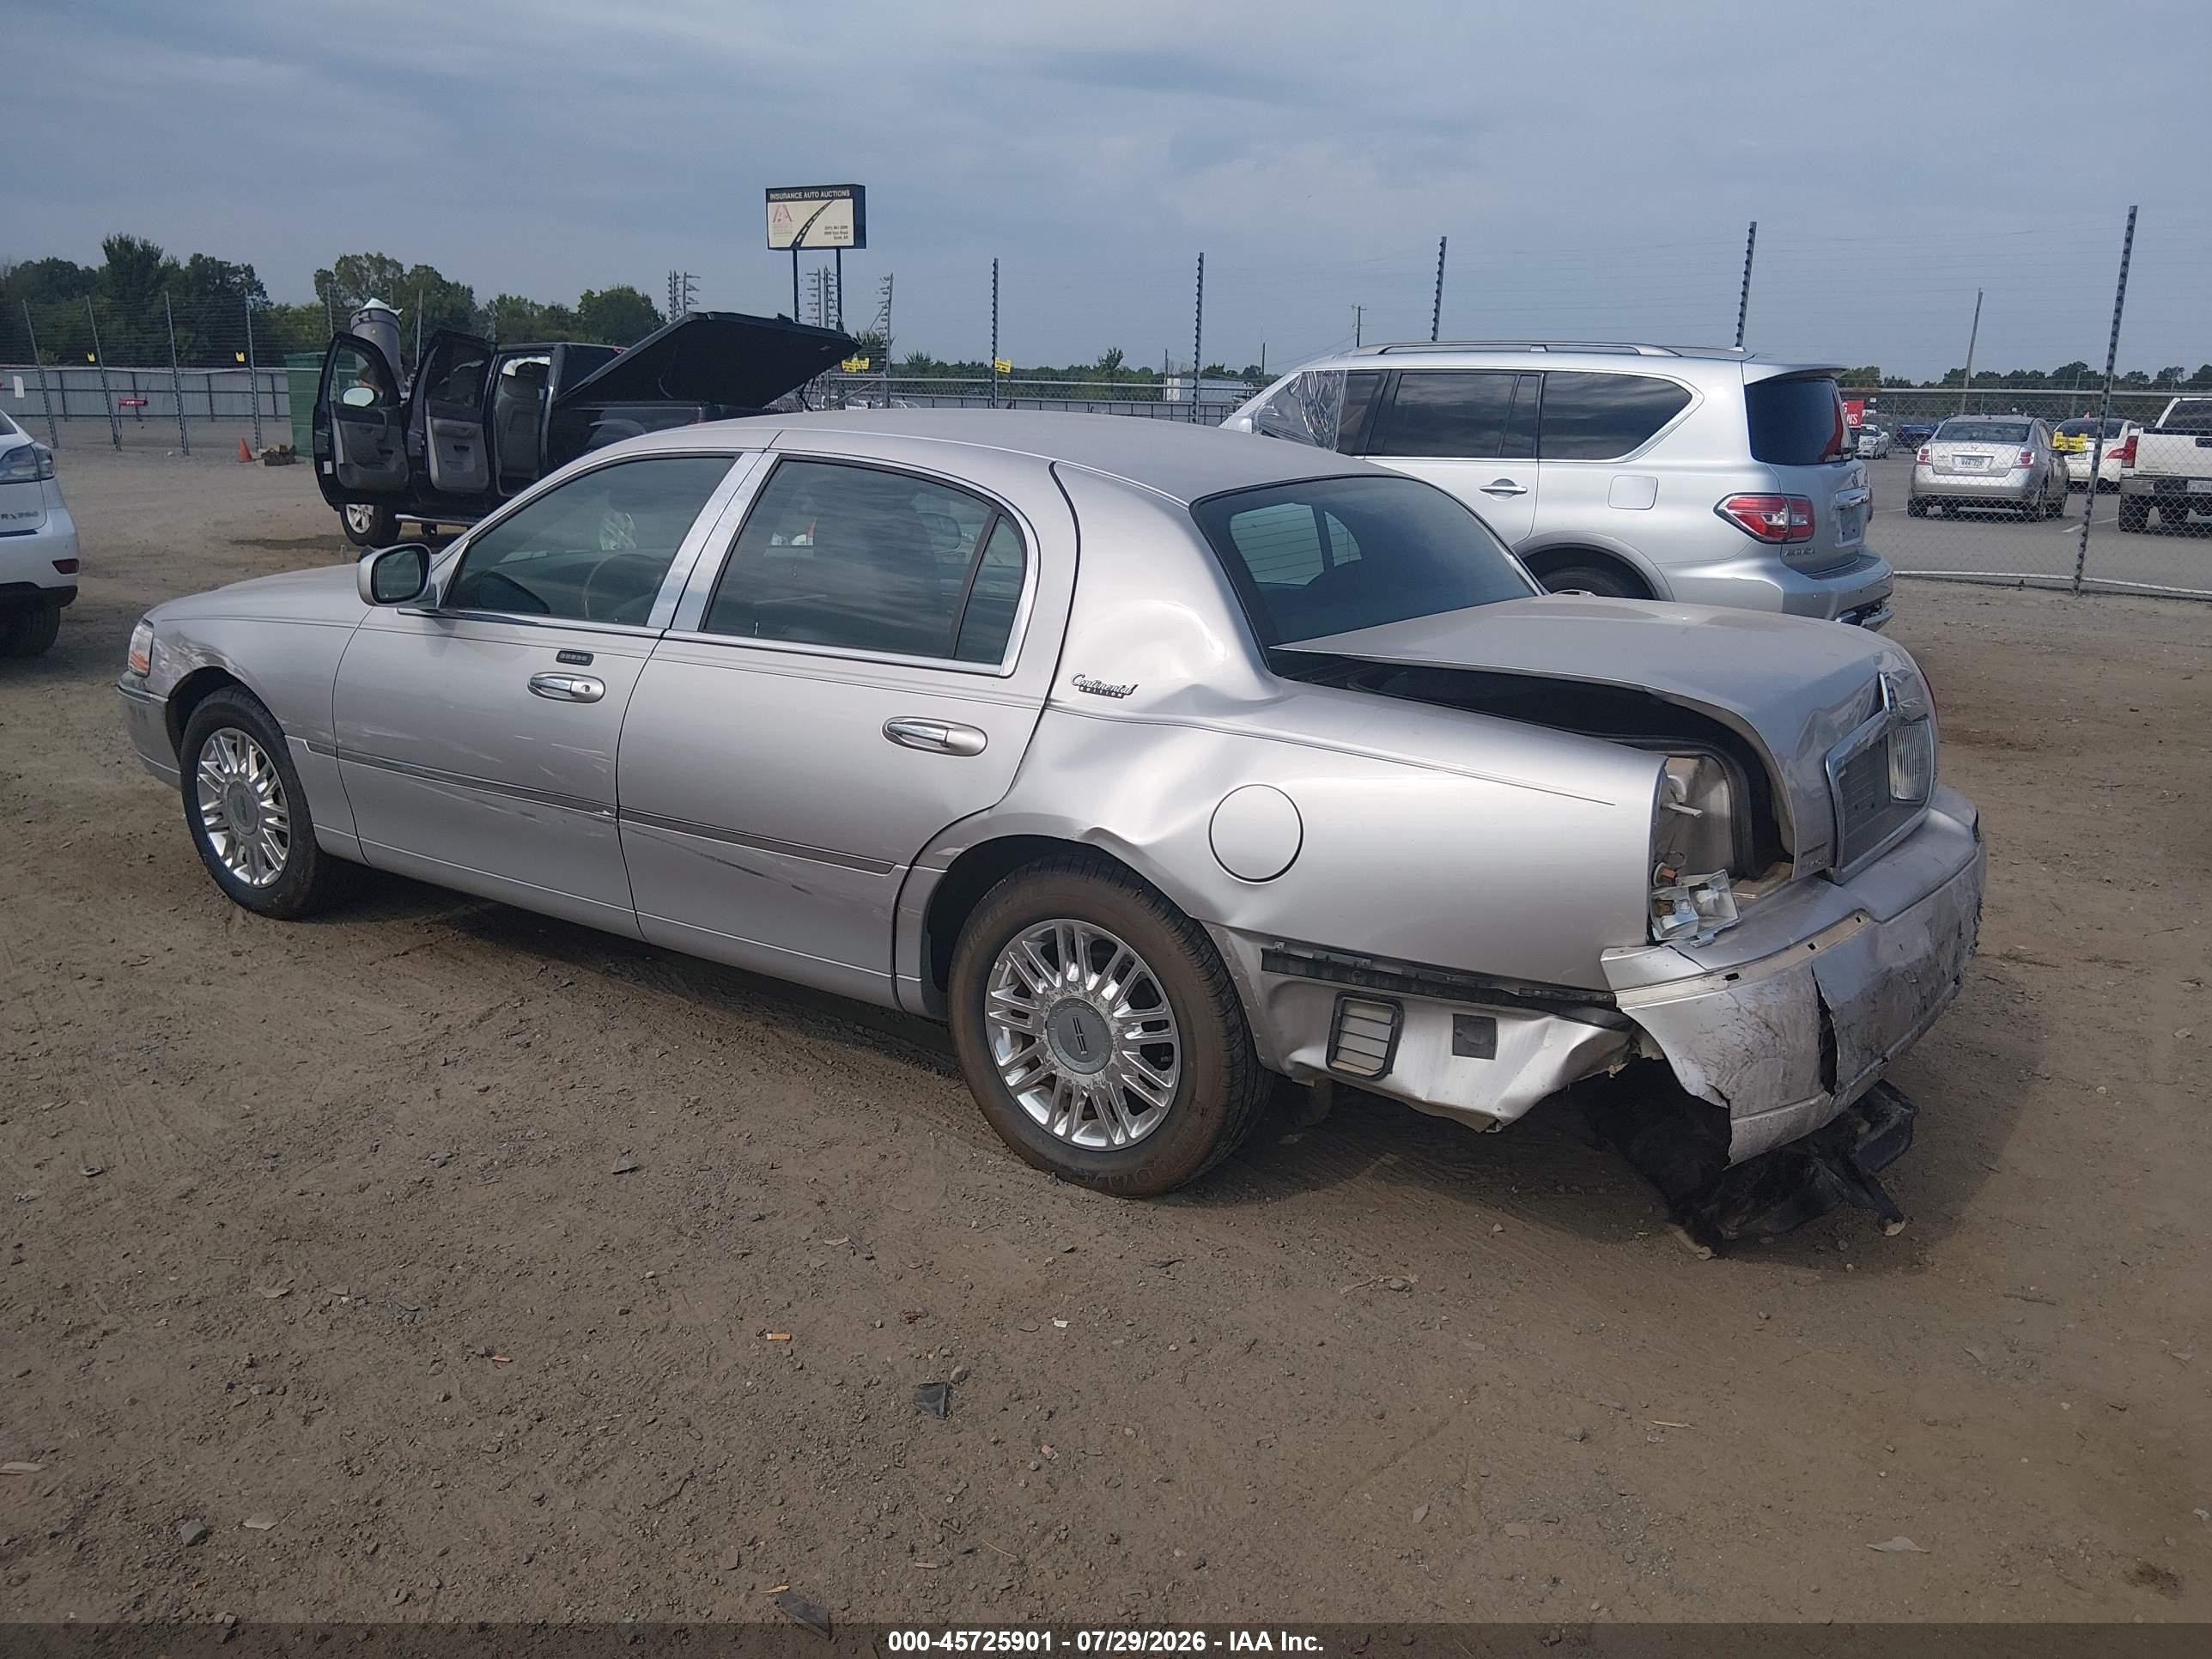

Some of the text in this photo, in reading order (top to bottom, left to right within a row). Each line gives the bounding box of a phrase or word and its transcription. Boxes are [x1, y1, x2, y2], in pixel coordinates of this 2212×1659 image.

[769, 189, 850, 200] INSURANCE AUTO AUCTIONS
[1071, 673, 1139, 696] Continental
